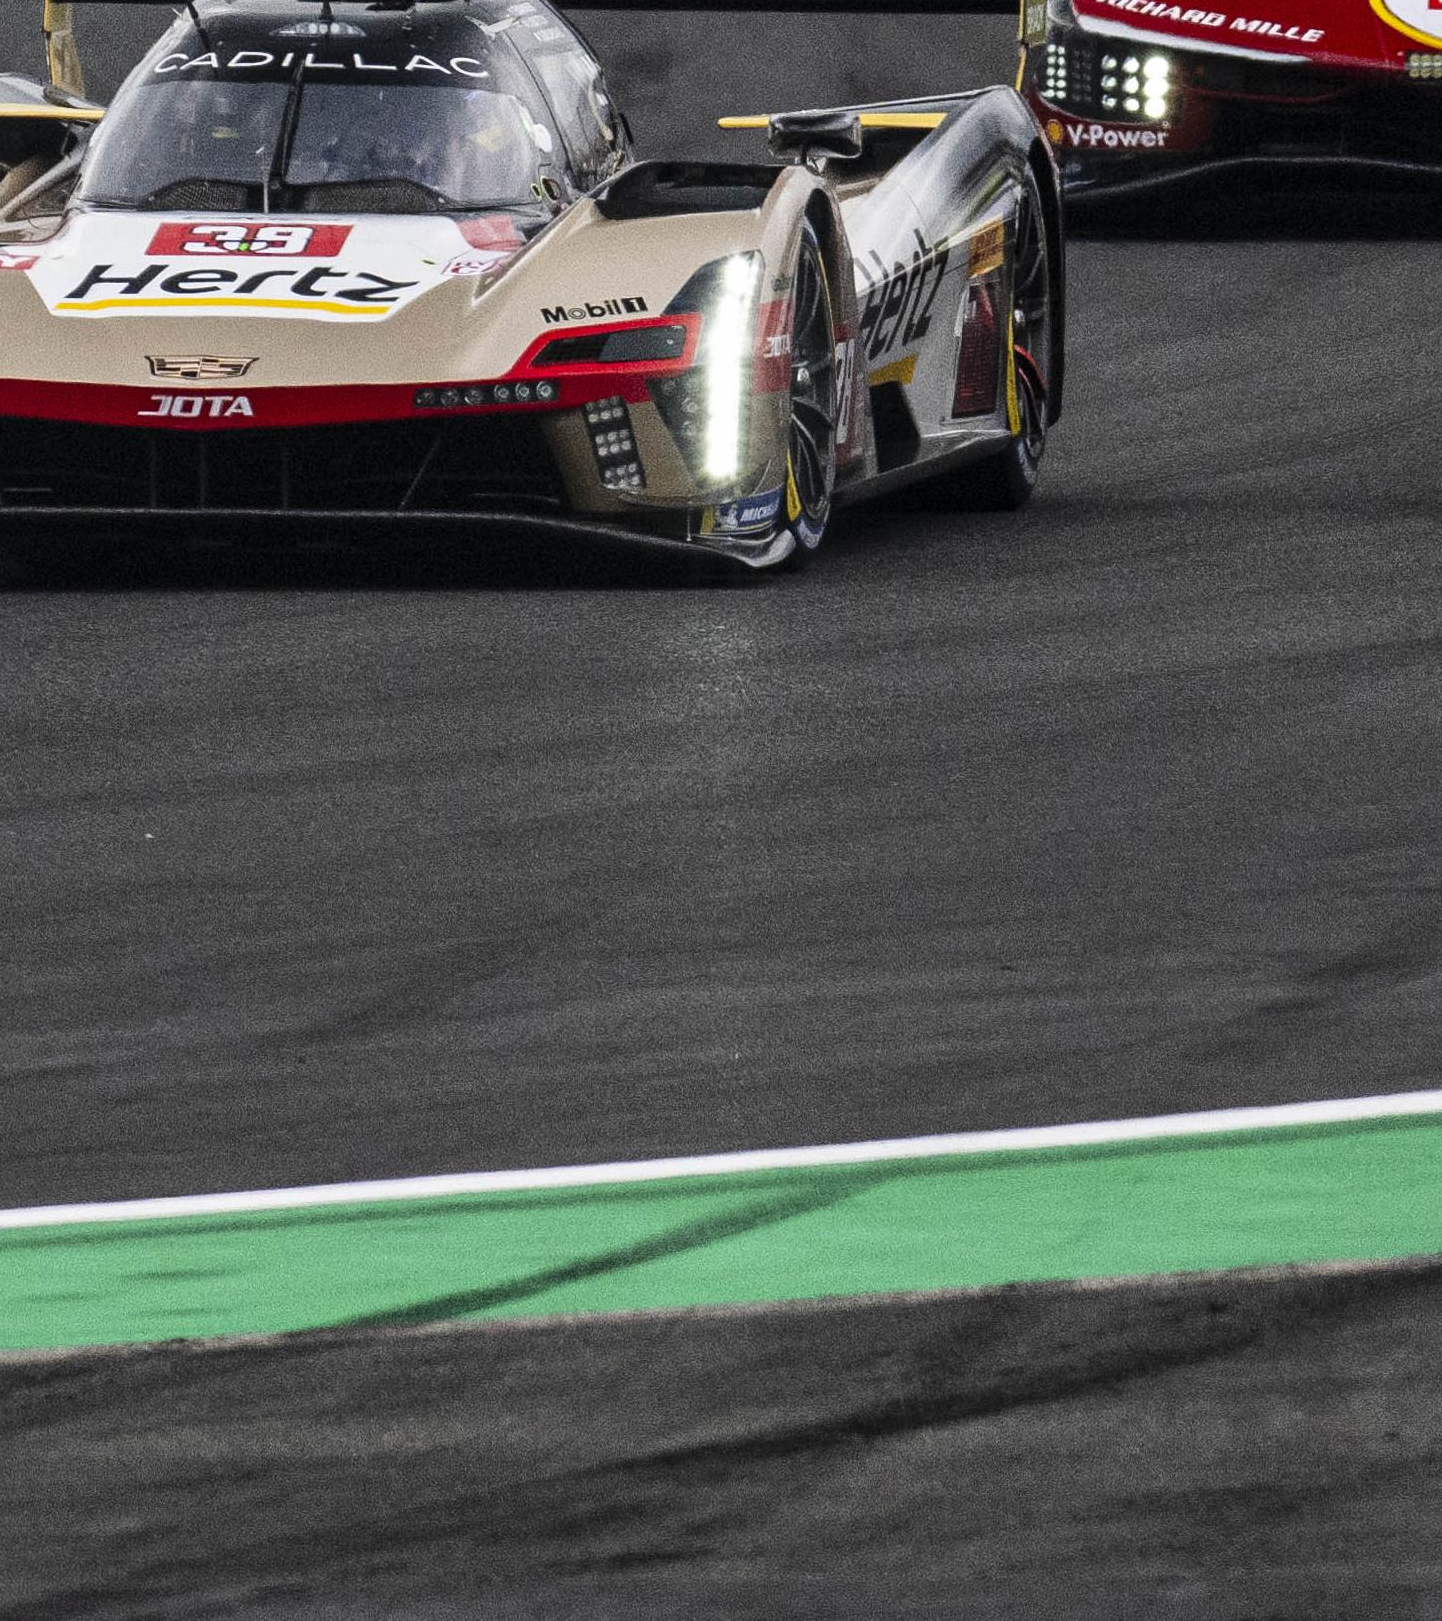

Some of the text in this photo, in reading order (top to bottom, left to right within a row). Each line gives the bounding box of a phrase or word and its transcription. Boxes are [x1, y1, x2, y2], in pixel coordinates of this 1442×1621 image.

[1229, 17, 1325, 43] MILLE
[153, 50, 490, 78] CADILLAC
[1066, 123, 1169, 147] V-Power
[64, 263, 420, 303] Hertz
[541, 298, 622, 324] Mobil
[138, 395, 254, 418] JOTA
